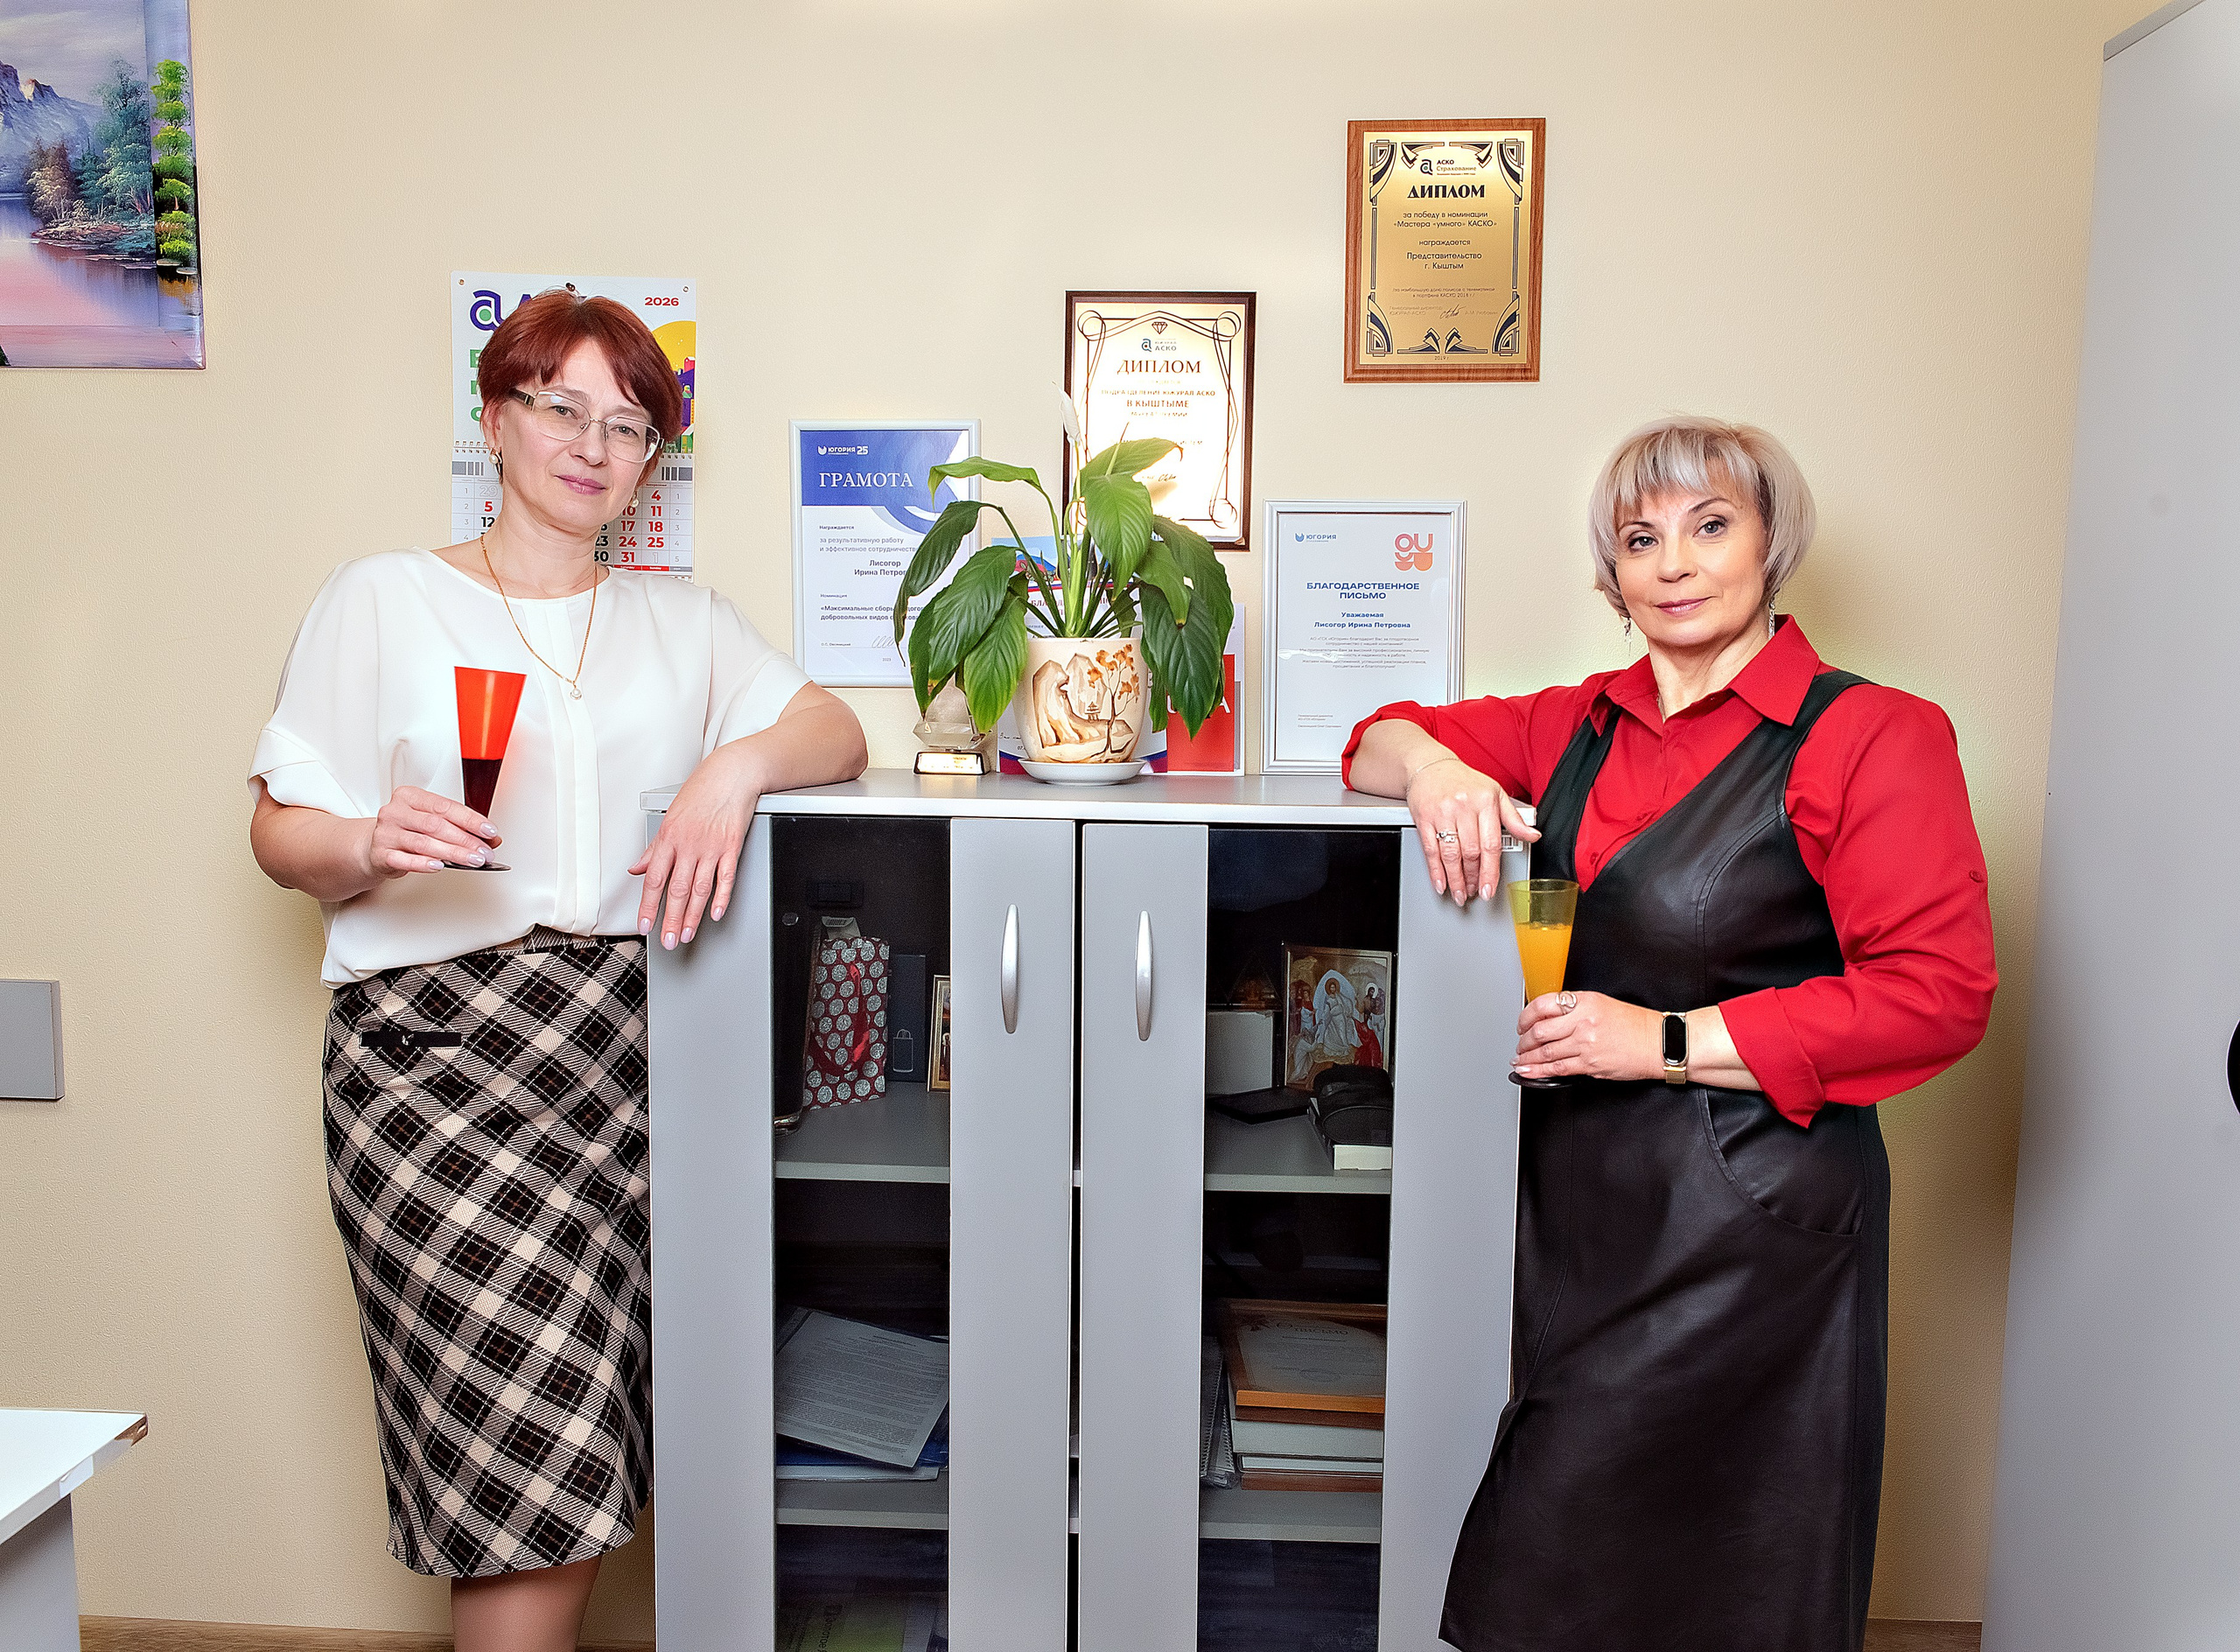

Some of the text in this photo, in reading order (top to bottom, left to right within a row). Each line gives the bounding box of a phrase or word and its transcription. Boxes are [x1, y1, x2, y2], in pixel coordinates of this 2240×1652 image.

[1407, 185, 1485, 198] ДИПЛОМ
[1406, 252, 1482, 261] Представительство
[644, 297, 679, 306] 2026
[1116, 360, 1201, 374] ДИПЛОМ
[857, 445, 869, 455] 25
[819, 472, 914, 487] ГРАМОТА
[651, 490, 662, 501] 4
[484, 501, 494, 512] 5
[651, 506, 662, 517] 11
[480, 516, 495, 528] 12
[620, 521, 635, 532] 17
[648, 521, 663, 533] 18
[619, 536, 637, 547] 24
[647, 536, 664, 548] 25
[620, 551, 635, 563] 31
